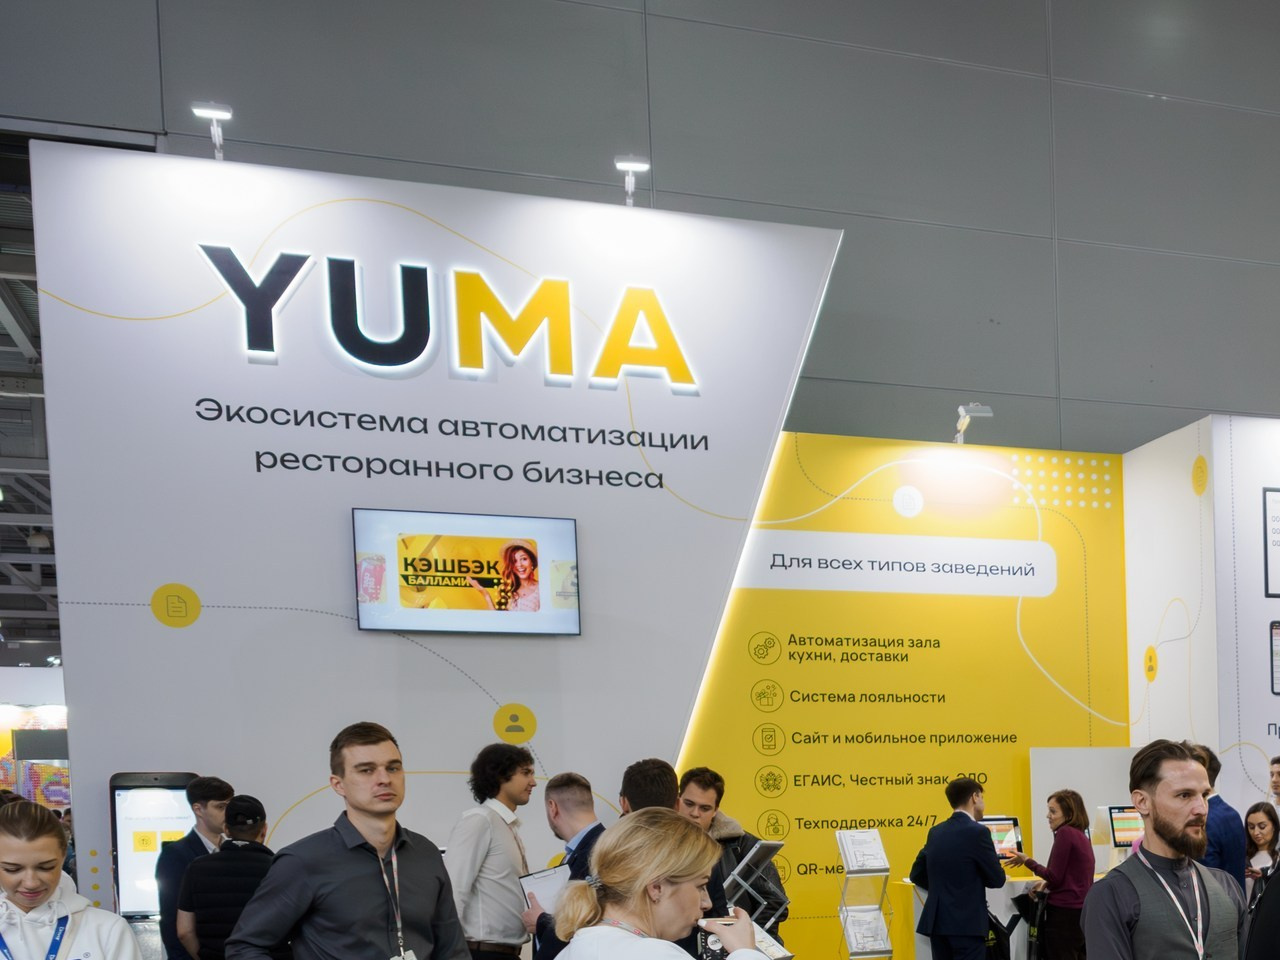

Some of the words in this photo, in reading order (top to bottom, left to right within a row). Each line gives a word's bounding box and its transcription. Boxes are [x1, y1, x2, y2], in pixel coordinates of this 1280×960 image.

[198, 244, 698, 387] YUMA
[195, 397, 429, 435] Экосистема
[438, 417, 710, 452] автоматизации
[255, 448, 514, 484] ресторанного
[522, 458, 665, 490] бизнеса
[403, 557, 500, 575] КЭШБЭК
[770, 554, 812, 570] Для
[818, 559, 863, 571] всех
[868, 559, 926, 573] типов
[931, 561, 1035, 577] заведений
[408, 575, 470, 587] БАЛЛАМИ
[787, 634, 904, 650] Автоматизация
[907, 637, 940, 648] зала
[788, 651, 836, 664] кухни,
[840, 651, 908, 662] доставки
[790, 690, 856, 703] Система
[860, 691, 946, 704] лояльности
[791, 731, 829, 744] Сайт
[833, 734, 841, 743] и
[844, 731, 926, 744] мобильное
[929, 731, 1018, 745] приложение
[793, 774, 846, 787] ЕГАИС,
[849, 773, 914, 787] Честный
[795, 816, 904, 831] Техподдержка
[907, 815, 937, 827] 24/7
